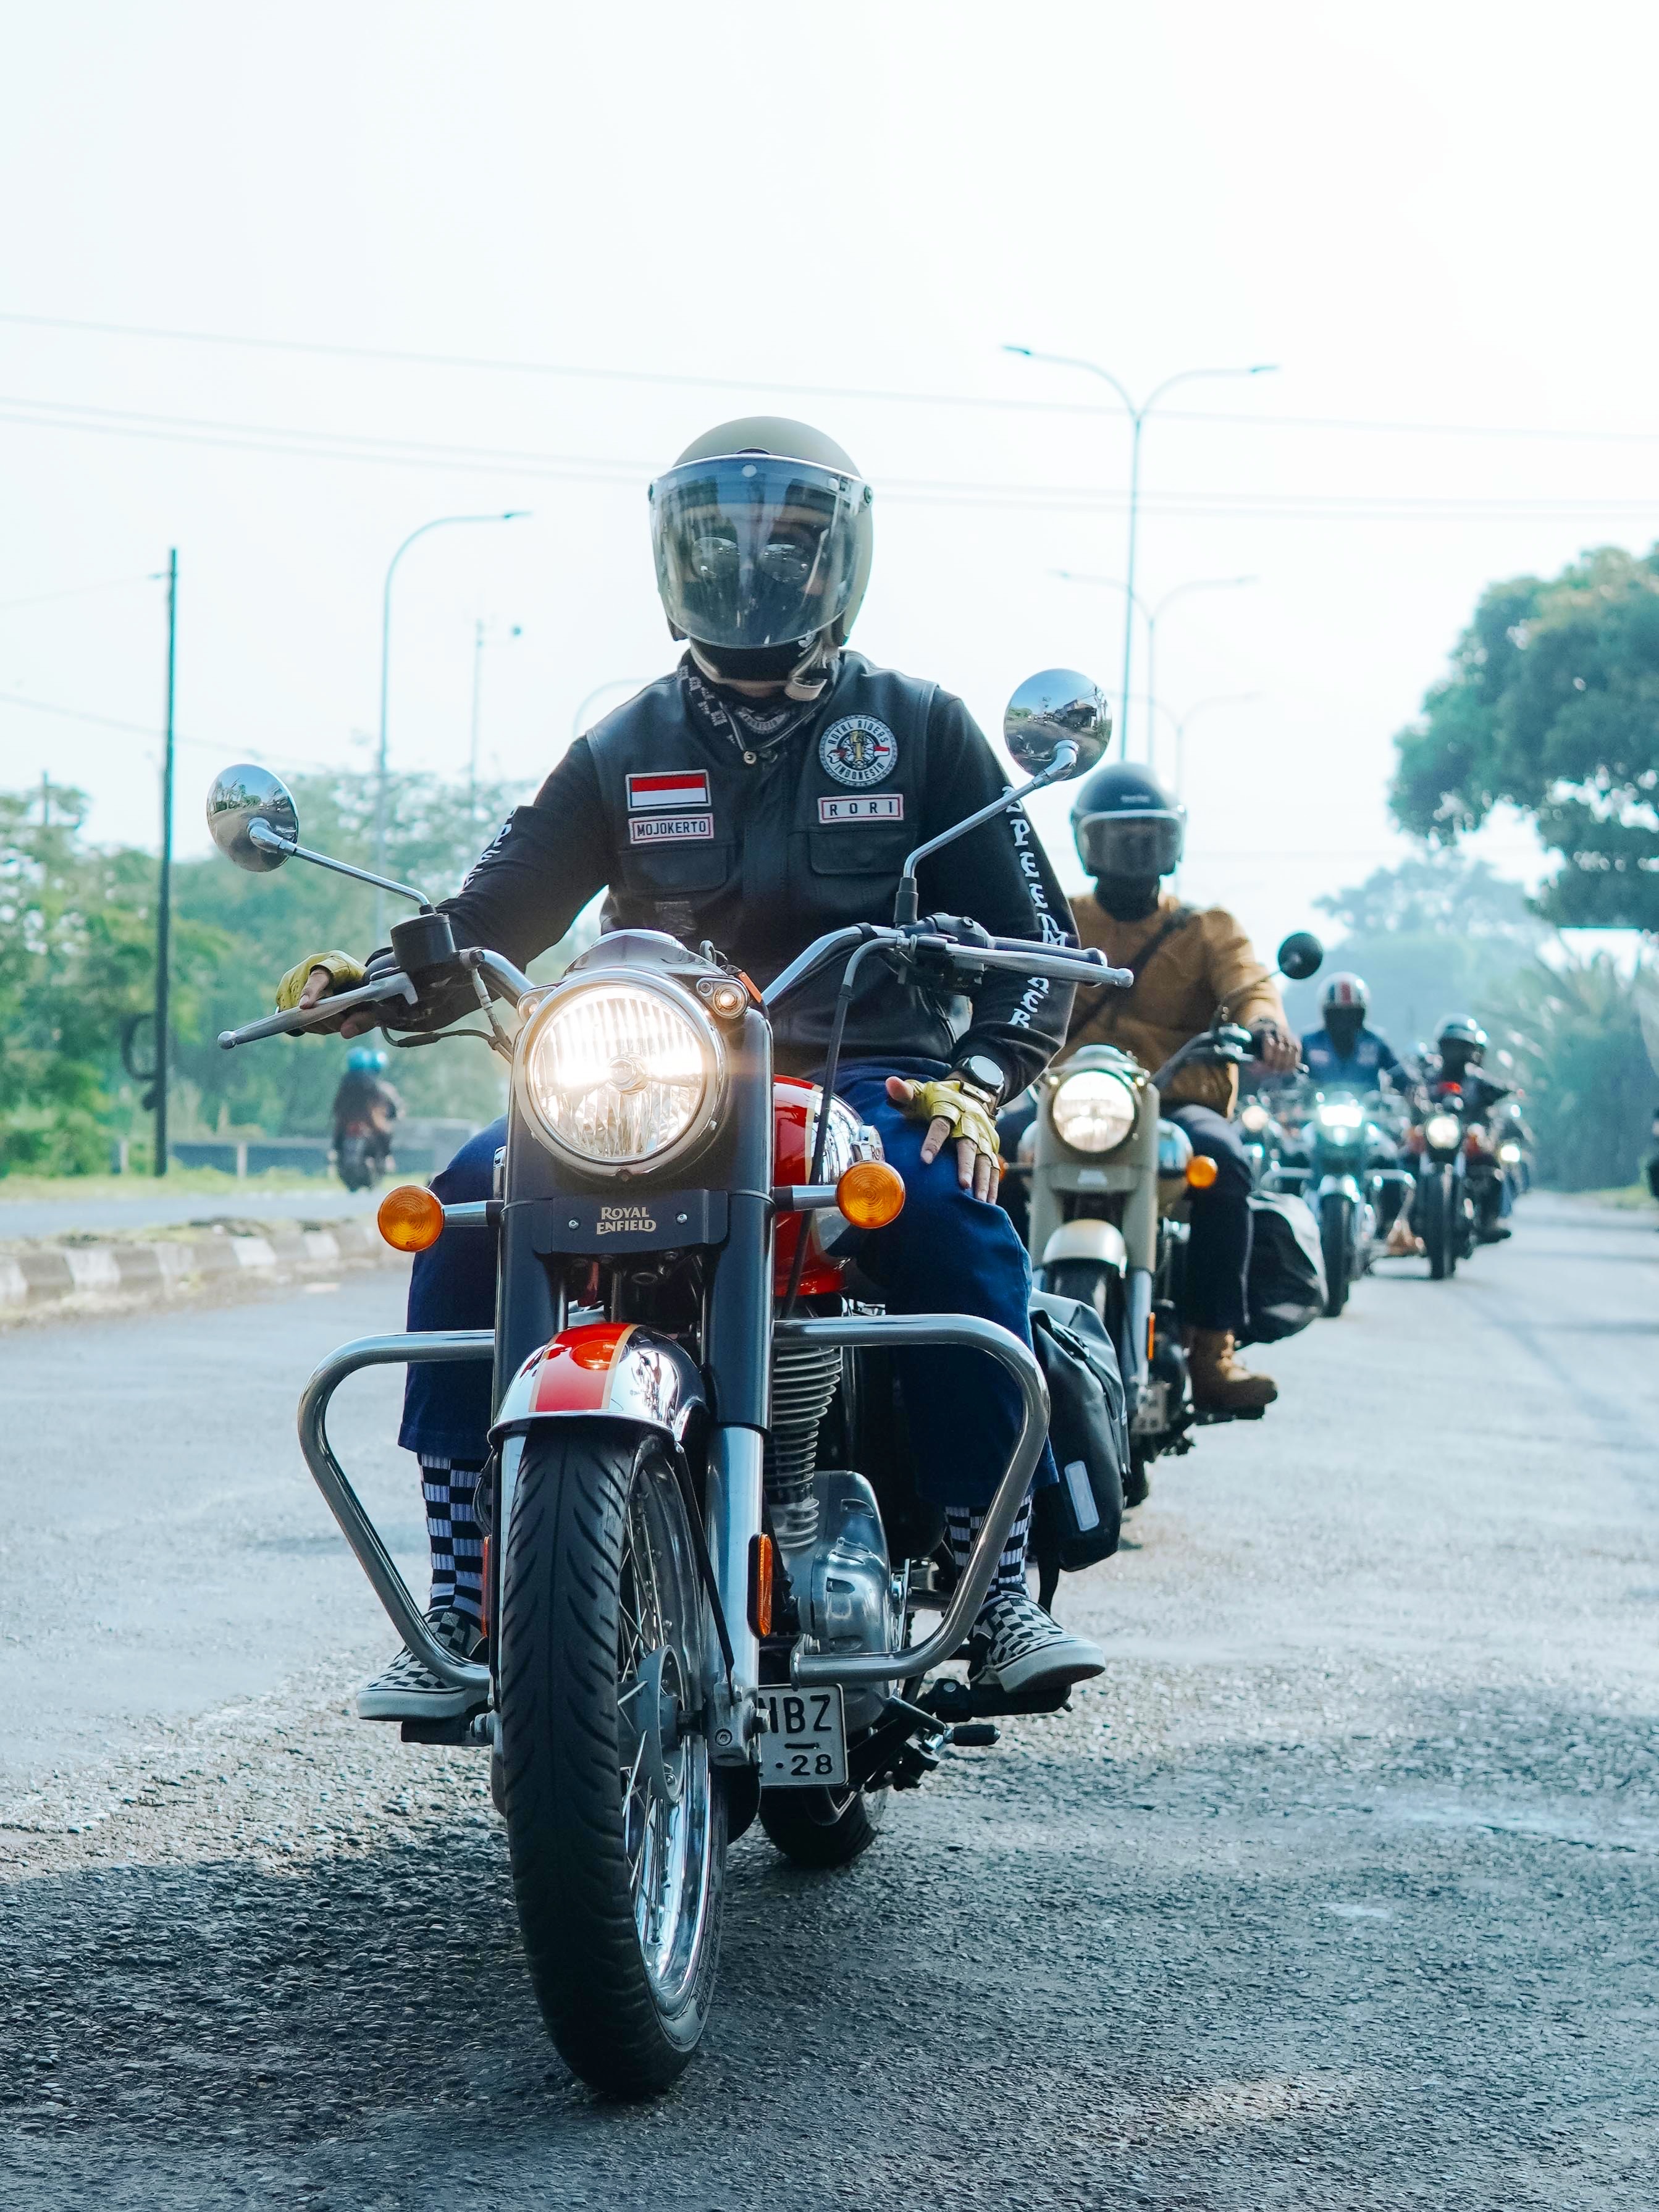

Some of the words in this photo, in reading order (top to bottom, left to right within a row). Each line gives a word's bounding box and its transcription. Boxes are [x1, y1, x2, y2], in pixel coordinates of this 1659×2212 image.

[857, 720, 889, 743] RIDERS
[834, 762, 886, 780] INDONESIA
[637, 820, 707, 836] MOJOKERTO
[600, 1206, 650, 1221] ROYAL
[596, 1219, 657, 1235] ENFIELD
